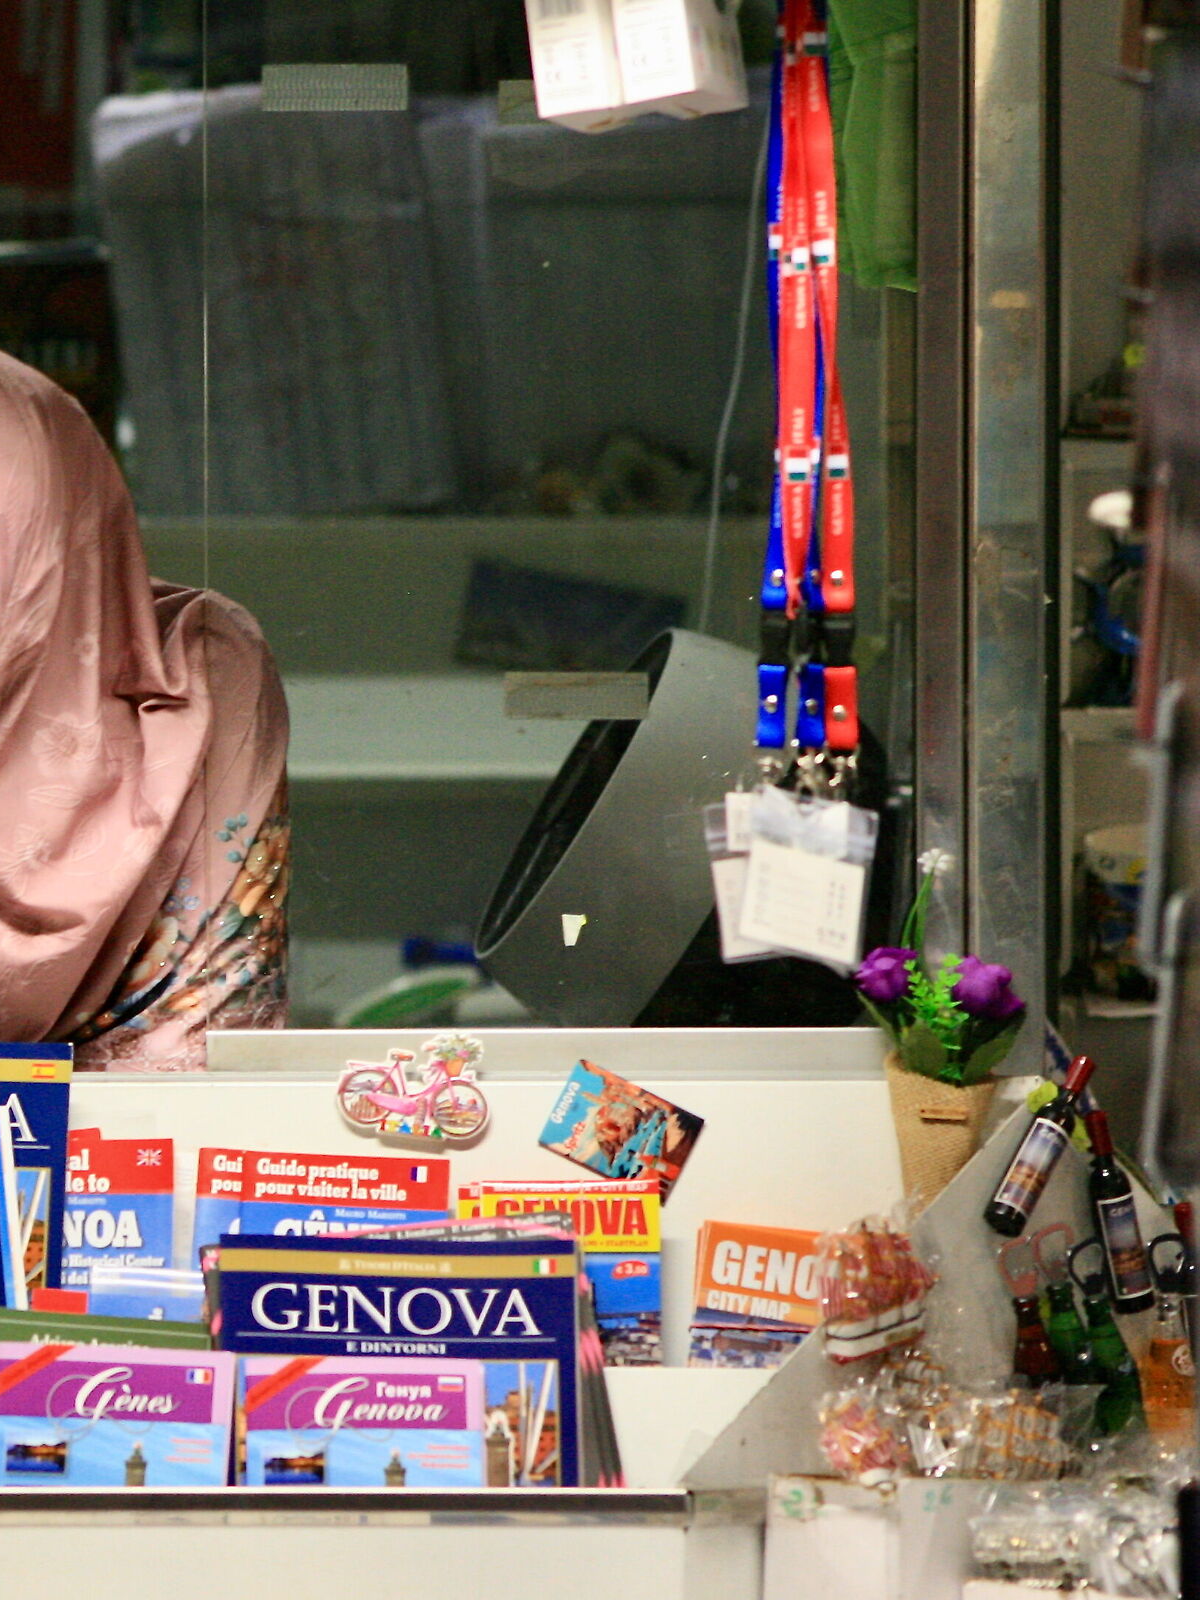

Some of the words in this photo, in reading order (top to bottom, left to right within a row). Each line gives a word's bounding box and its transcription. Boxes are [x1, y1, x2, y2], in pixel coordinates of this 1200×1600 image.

[550, 1081, 581, 1124] Genova
[87, 1173, 111, 1193] to
[256, 1158, 306, 1177] Guide
[308, 1162, 379, 1185] pratique
[255, 1181, 294, 1198] pour
[297, 1178, 350, 1199] visiter
[352, 1181, 368, 1200] la
[370, 1184, 408, 1202] ville
[250, 1282, 543, 1337] GENOVA
[706, 1290, 750, 1315] CITY
[748, 1297, 792, 1322] MAP
[360, 1342, 447, 1355] DINTORNI
[70, 1366, 180, 1424] Gènes
[310, 1375, 448, 1432] Genova
[375, 1380, 432, 1400] Генуя
